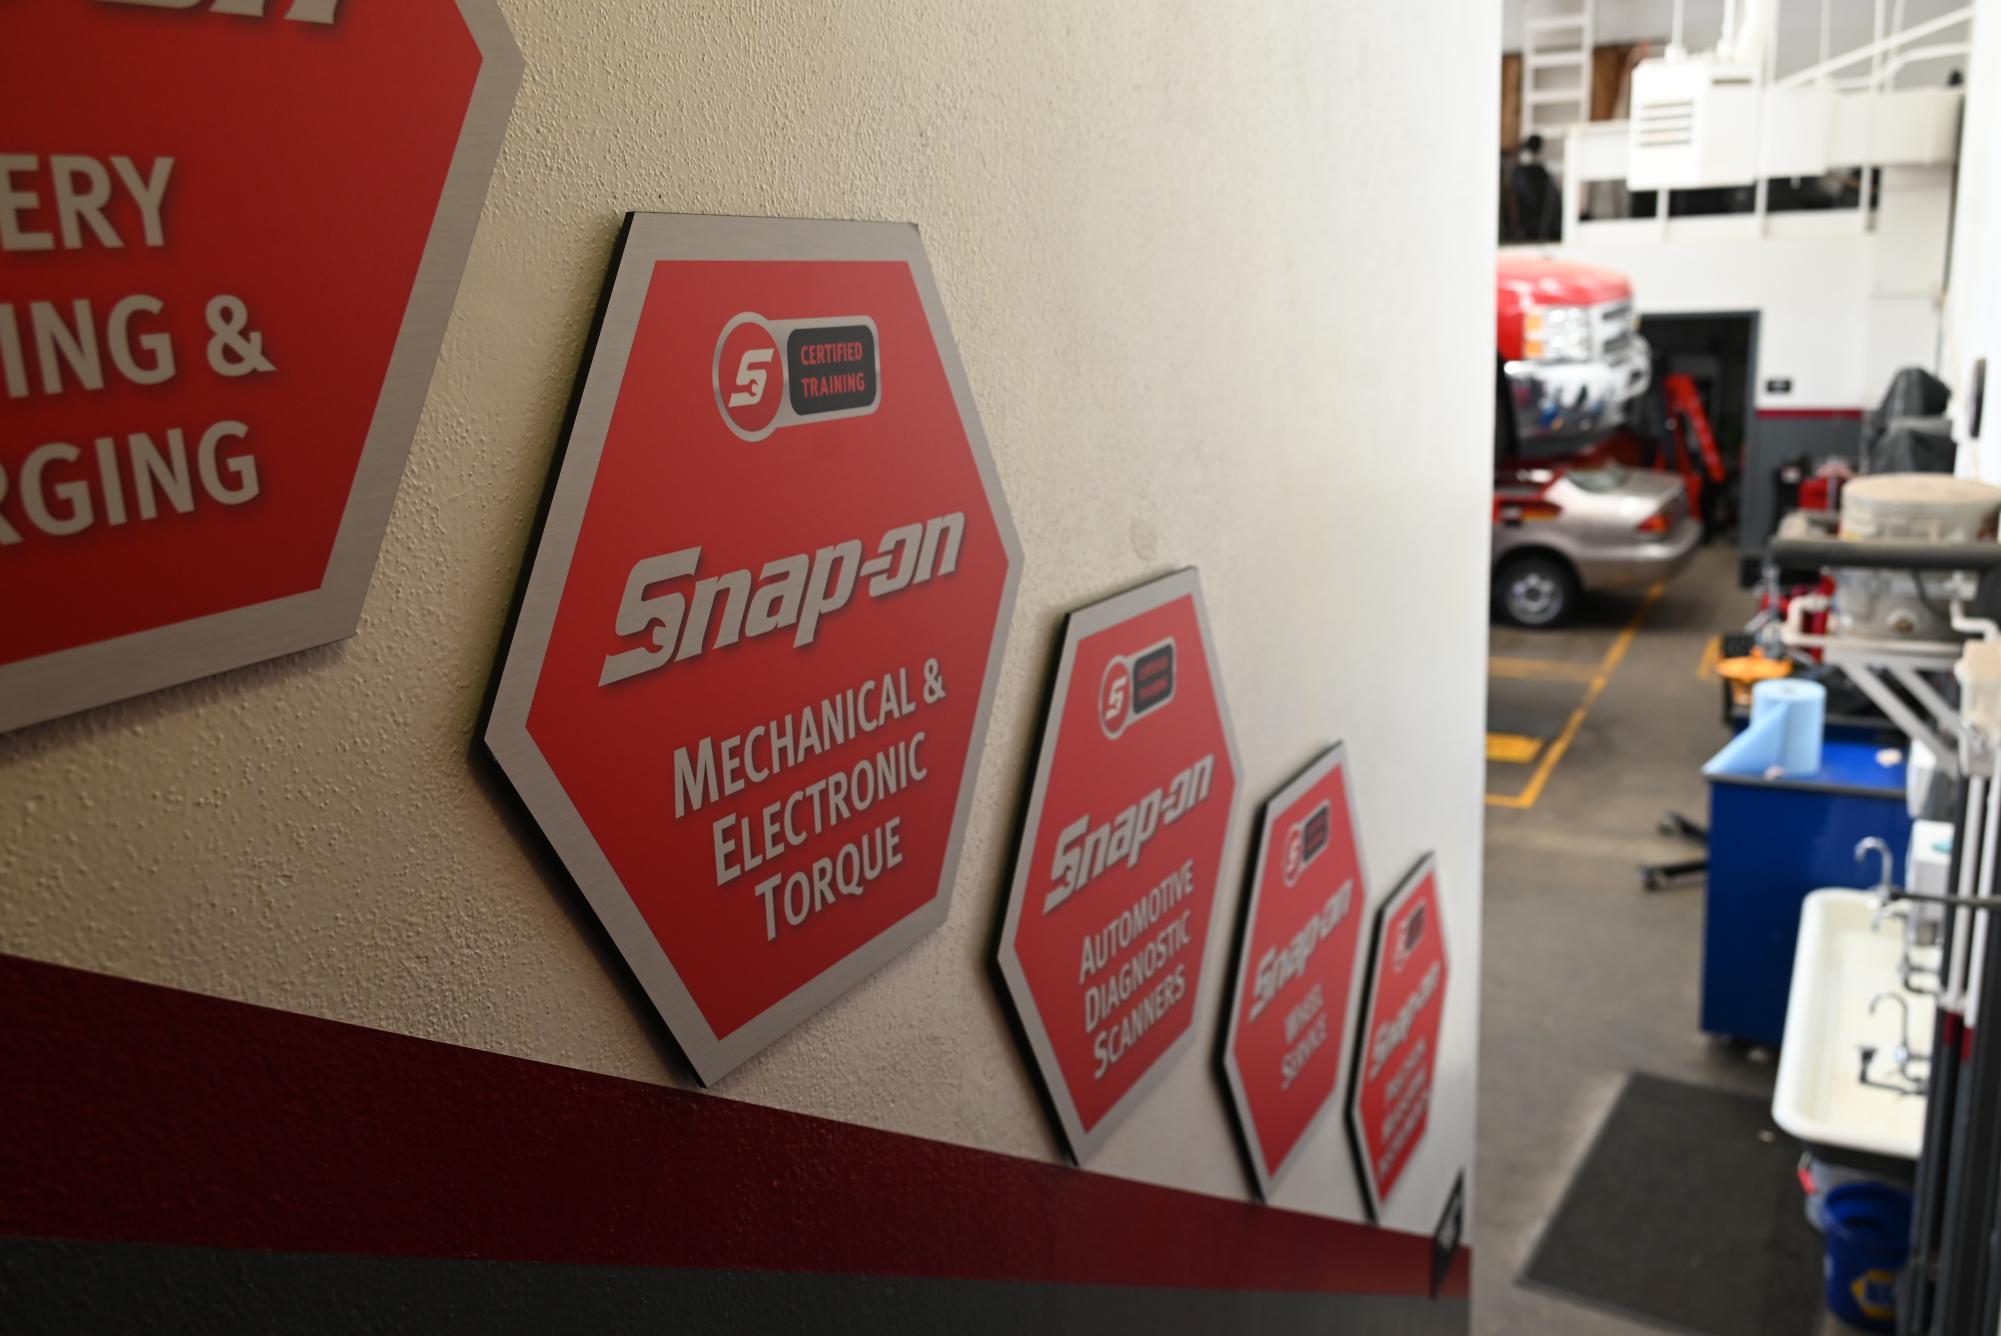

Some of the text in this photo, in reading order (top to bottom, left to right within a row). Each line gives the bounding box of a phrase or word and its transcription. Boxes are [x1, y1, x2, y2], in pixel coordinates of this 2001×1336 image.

[204, 294, 278, 377] &
[799, 341, 863, 366] CERTIFIED
[800, 371, 866, 398] TRAINING
[598, 511, 966, 688] Snap-on
[673, 657, 947, 820] MECHANICAL &
[711, 731, 929, 887] ELECTRONIC
[754, 815, 904, 942] TORQUE
[1042, 753, 1215, 916] Snap-on
